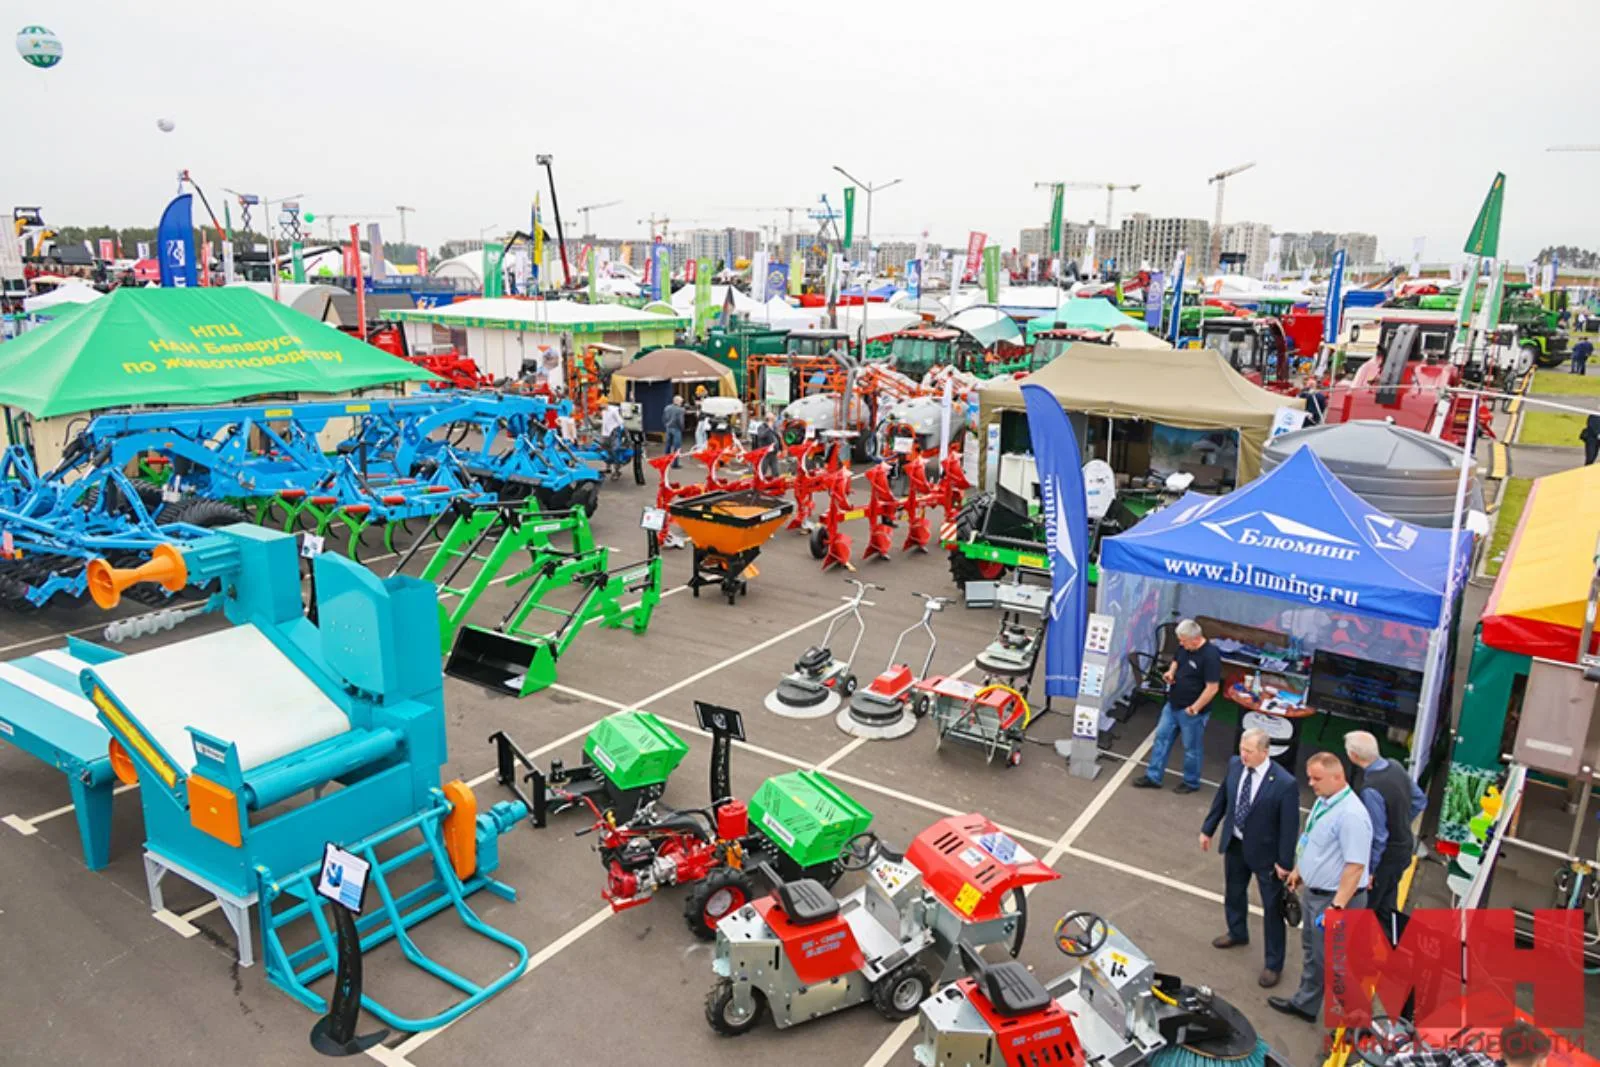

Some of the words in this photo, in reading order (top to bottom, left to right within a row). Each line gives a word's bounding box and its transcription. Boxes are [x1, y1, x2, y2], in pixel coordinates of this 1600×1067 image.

[190, 323, 242, 338] НПЦ
[149, 339, 199, 354] НАН
[122, 361, 157, 374] по
[164, 351, 343, 369] животноводству
[1164, 557, 1360, 607] www.bluming.ru
